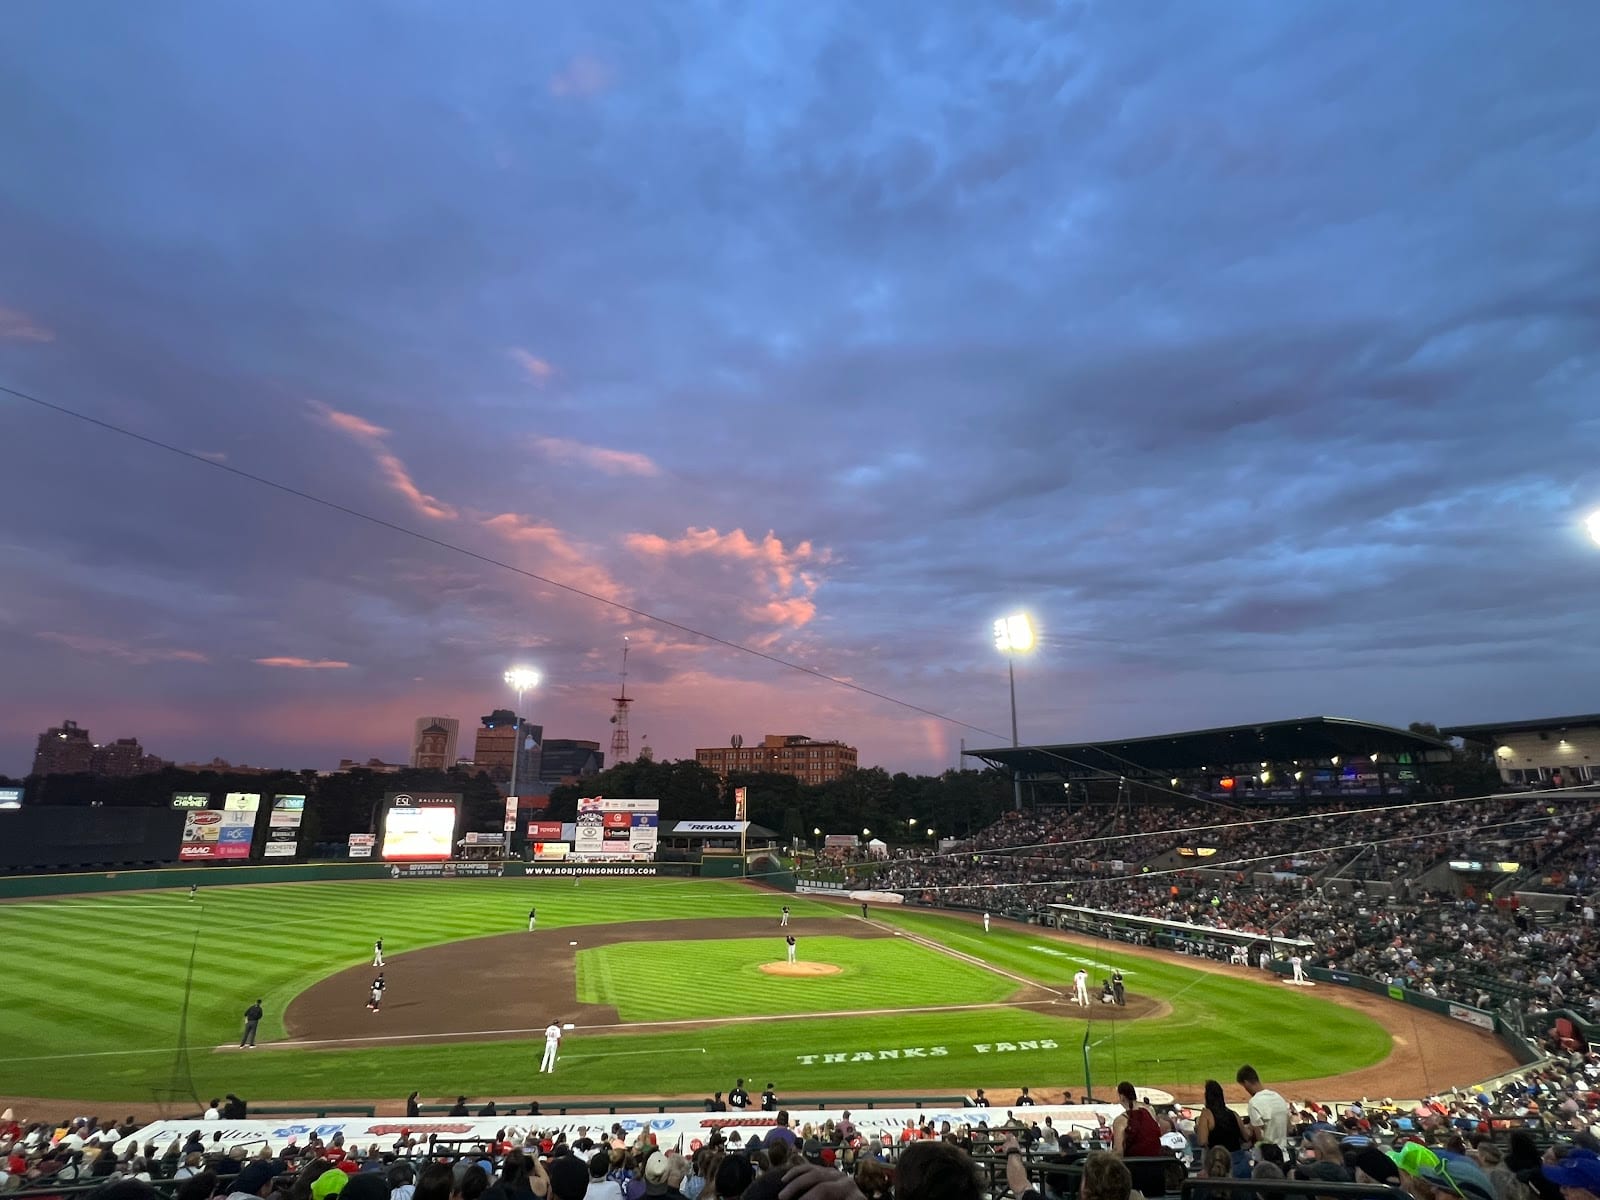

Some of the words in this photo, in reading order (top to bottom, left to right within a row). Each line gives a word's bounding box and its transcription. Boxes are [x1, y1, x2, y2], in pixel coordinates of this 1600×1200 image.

[395, 797, 411, 806] ESL
[525, 867, 657, 876] WWW.BOBJOHNSONUSED.COM
[796, 1046, 949, 1065] THANKS
[972, 1039, 1059, 1054] FANS
[732, 1095, 742, 1105] 46
